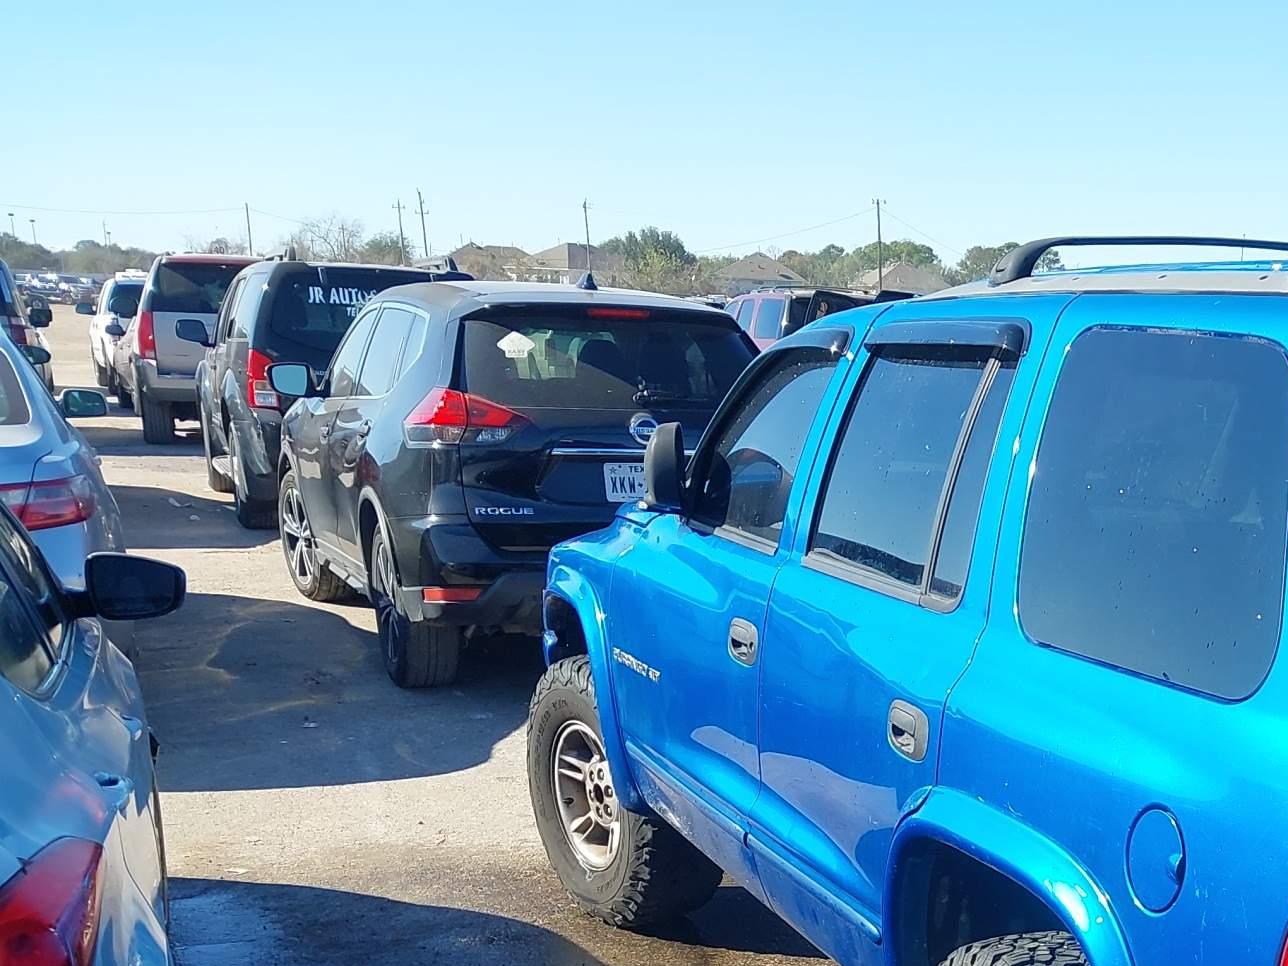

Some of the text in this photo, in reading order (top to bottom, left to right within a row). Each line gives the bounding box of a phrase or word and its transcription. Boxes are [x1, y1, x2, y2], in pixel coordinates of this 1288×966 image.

[308, 286, 326, 304] JR
[628, 465, 645, 474] TEX
[474, 507, 535, 515] ROGUE
